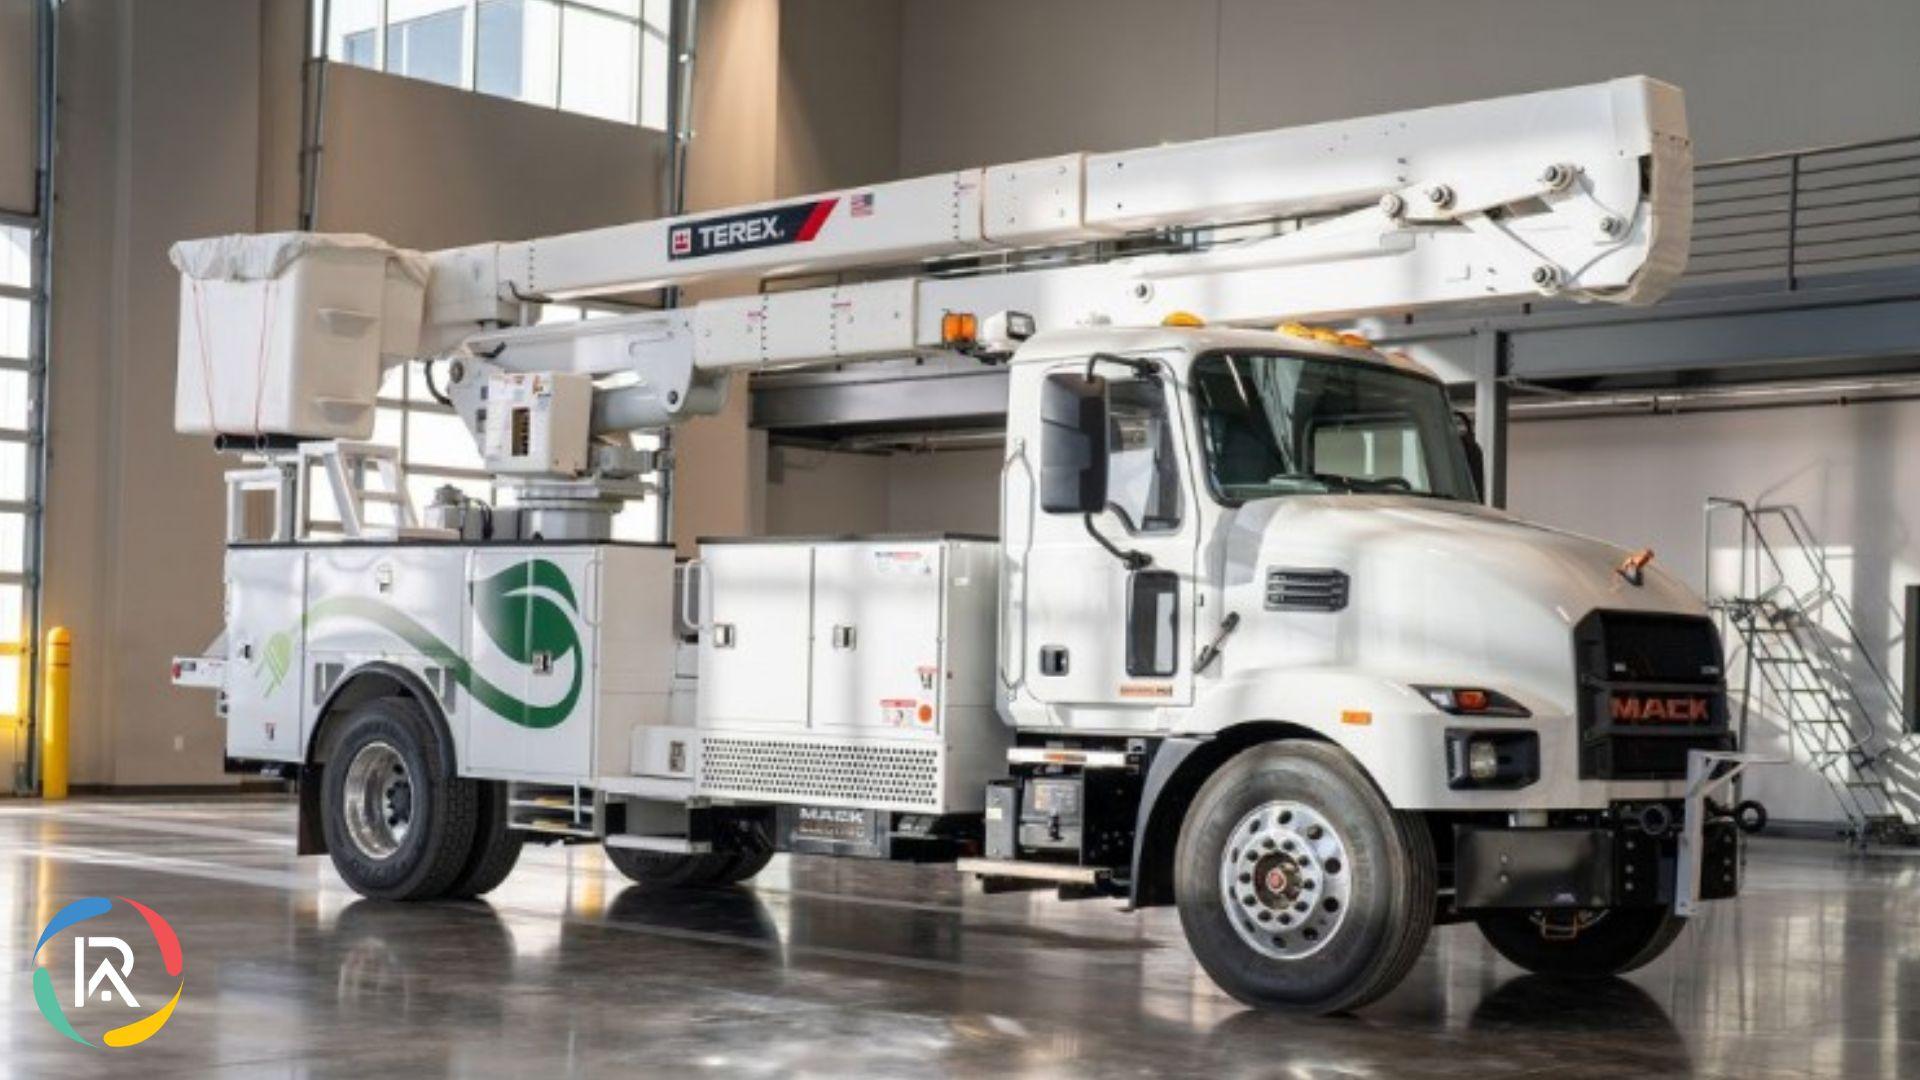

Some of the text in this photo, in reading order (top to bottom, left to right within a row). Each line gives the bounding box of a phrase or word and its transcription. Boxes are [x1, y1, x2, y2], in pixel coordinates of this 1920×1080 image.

[698, 215, 779, 249] TEREX
[1610, 697, 1708, 721] MACK
[799, 807, 864, 823] MACK
